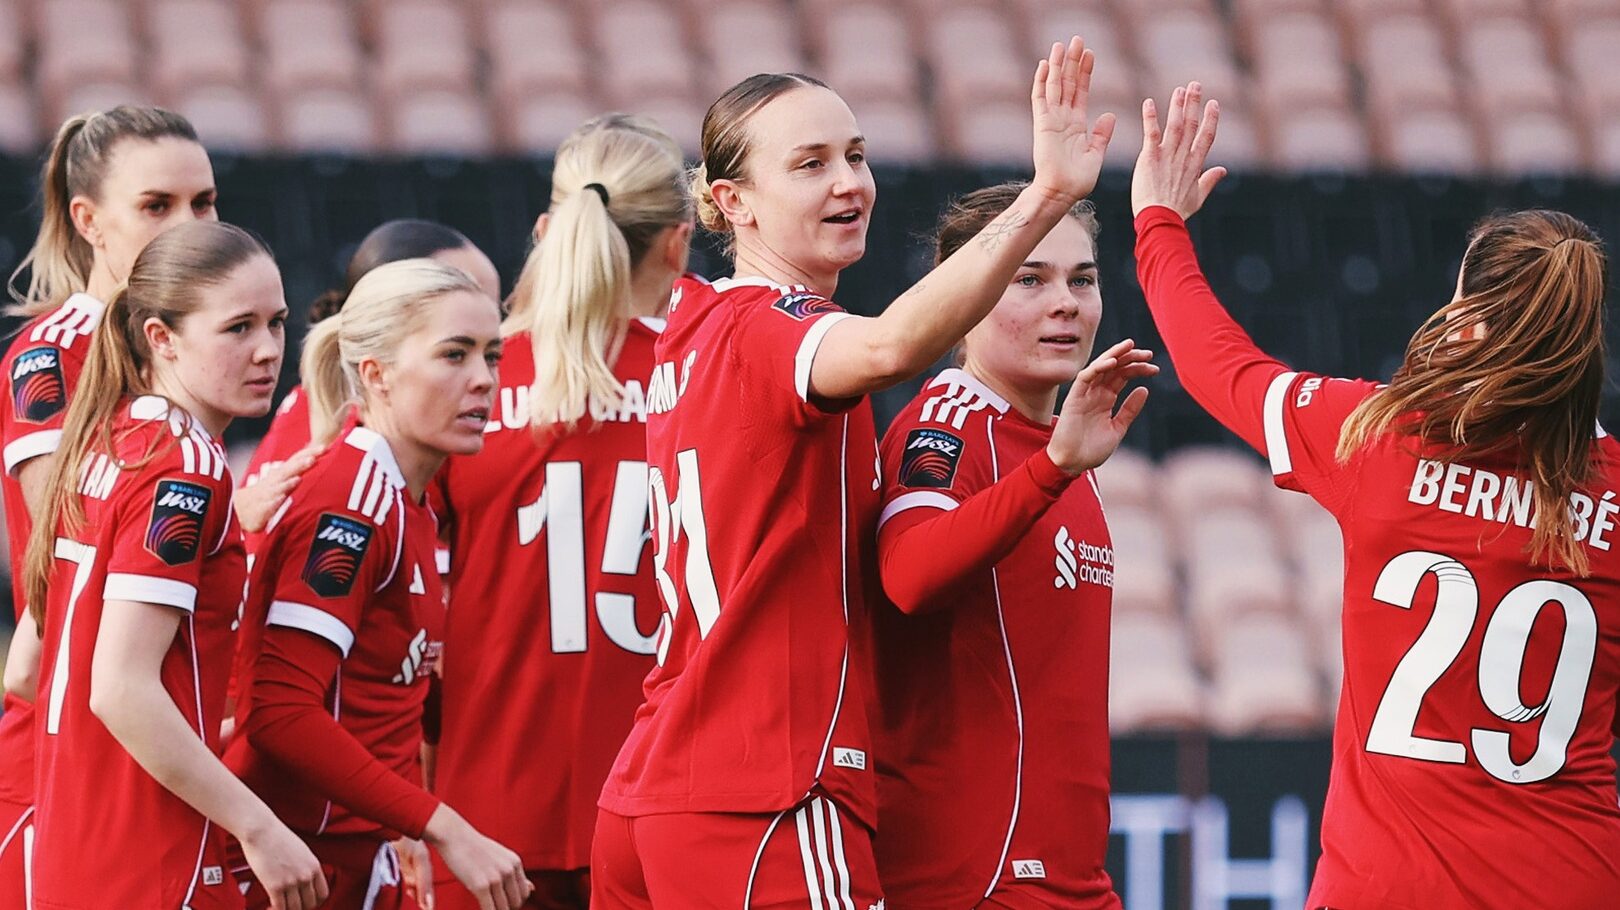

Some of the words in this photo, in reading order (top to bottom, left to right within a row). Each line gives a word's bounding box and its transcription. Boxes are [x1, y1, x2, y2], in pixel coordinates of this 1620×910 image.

[13, 354, 57, 380] WSL
[907, 436, 958, 457] WSL
[157, 491, 206, 515] WSL
[1407, 458, 1620, 551] BERNBÉ
[317, 525, 366, 551] WSL
[517, 460, 657, 655] 15
[47, 537, 97, 736] 7
[1366, 550, 1598, 784] 29
